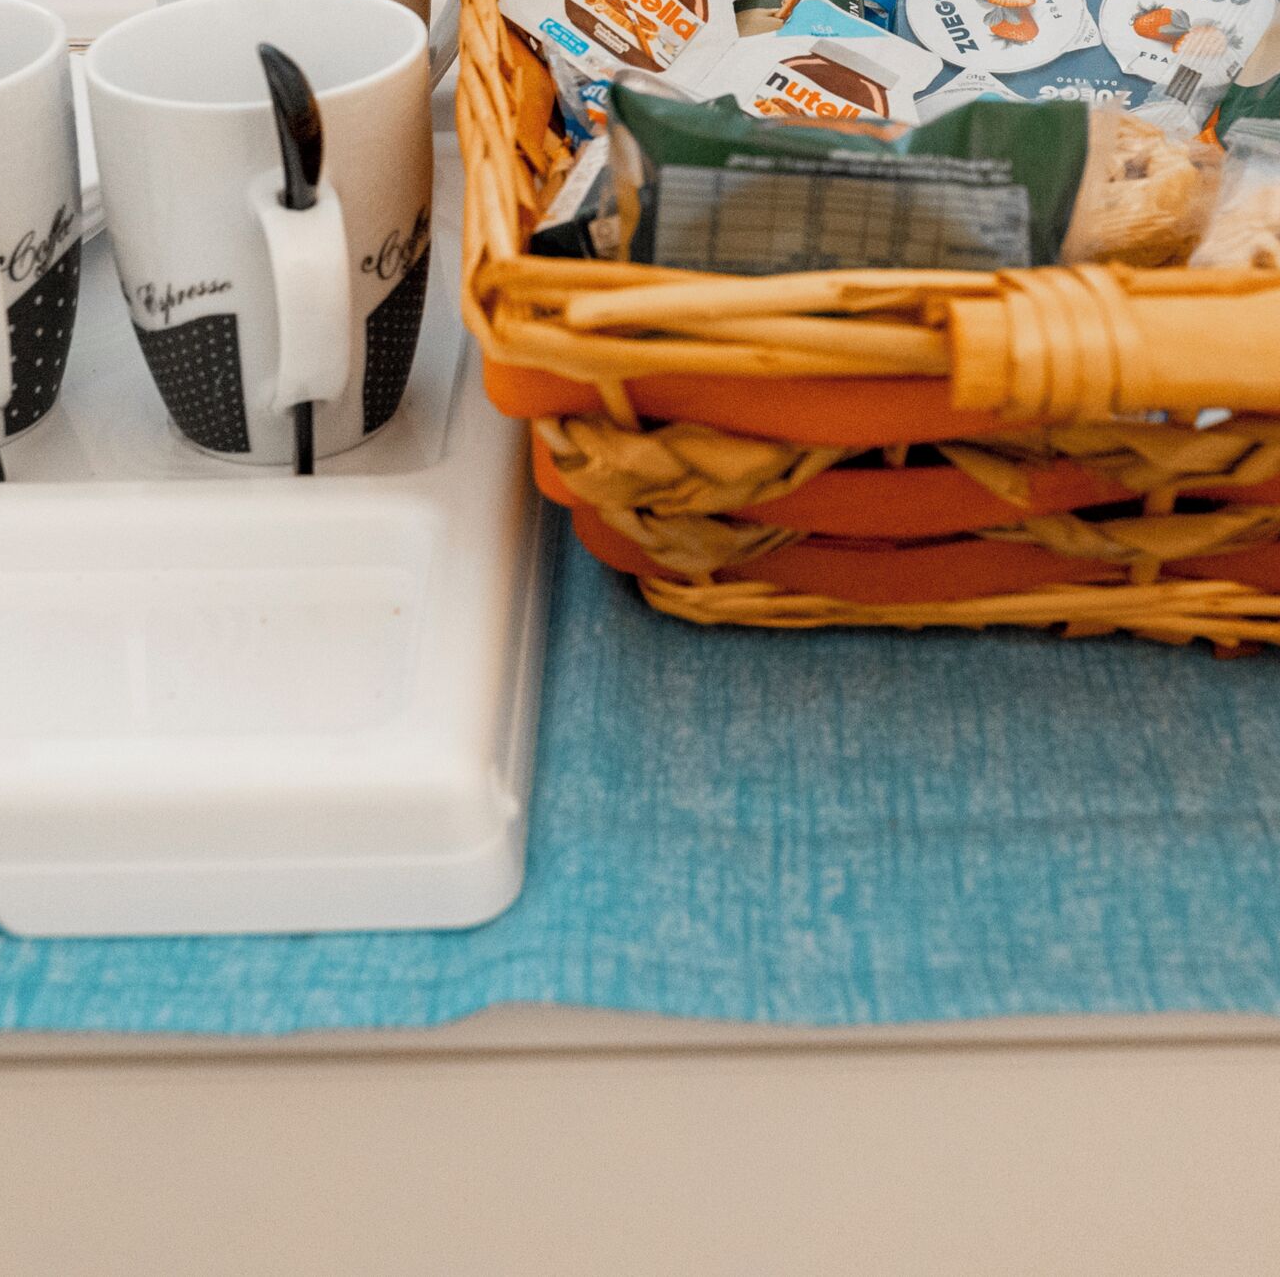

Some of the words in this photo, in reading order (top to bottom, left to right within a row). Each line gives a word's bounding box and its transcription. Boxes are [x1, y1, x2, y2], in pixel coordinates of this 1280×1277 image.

[1056, 75, 1086, 84] 1890
[1093, 77, 1118, 86] DAL
[765, 68, 861, 122] nutell
